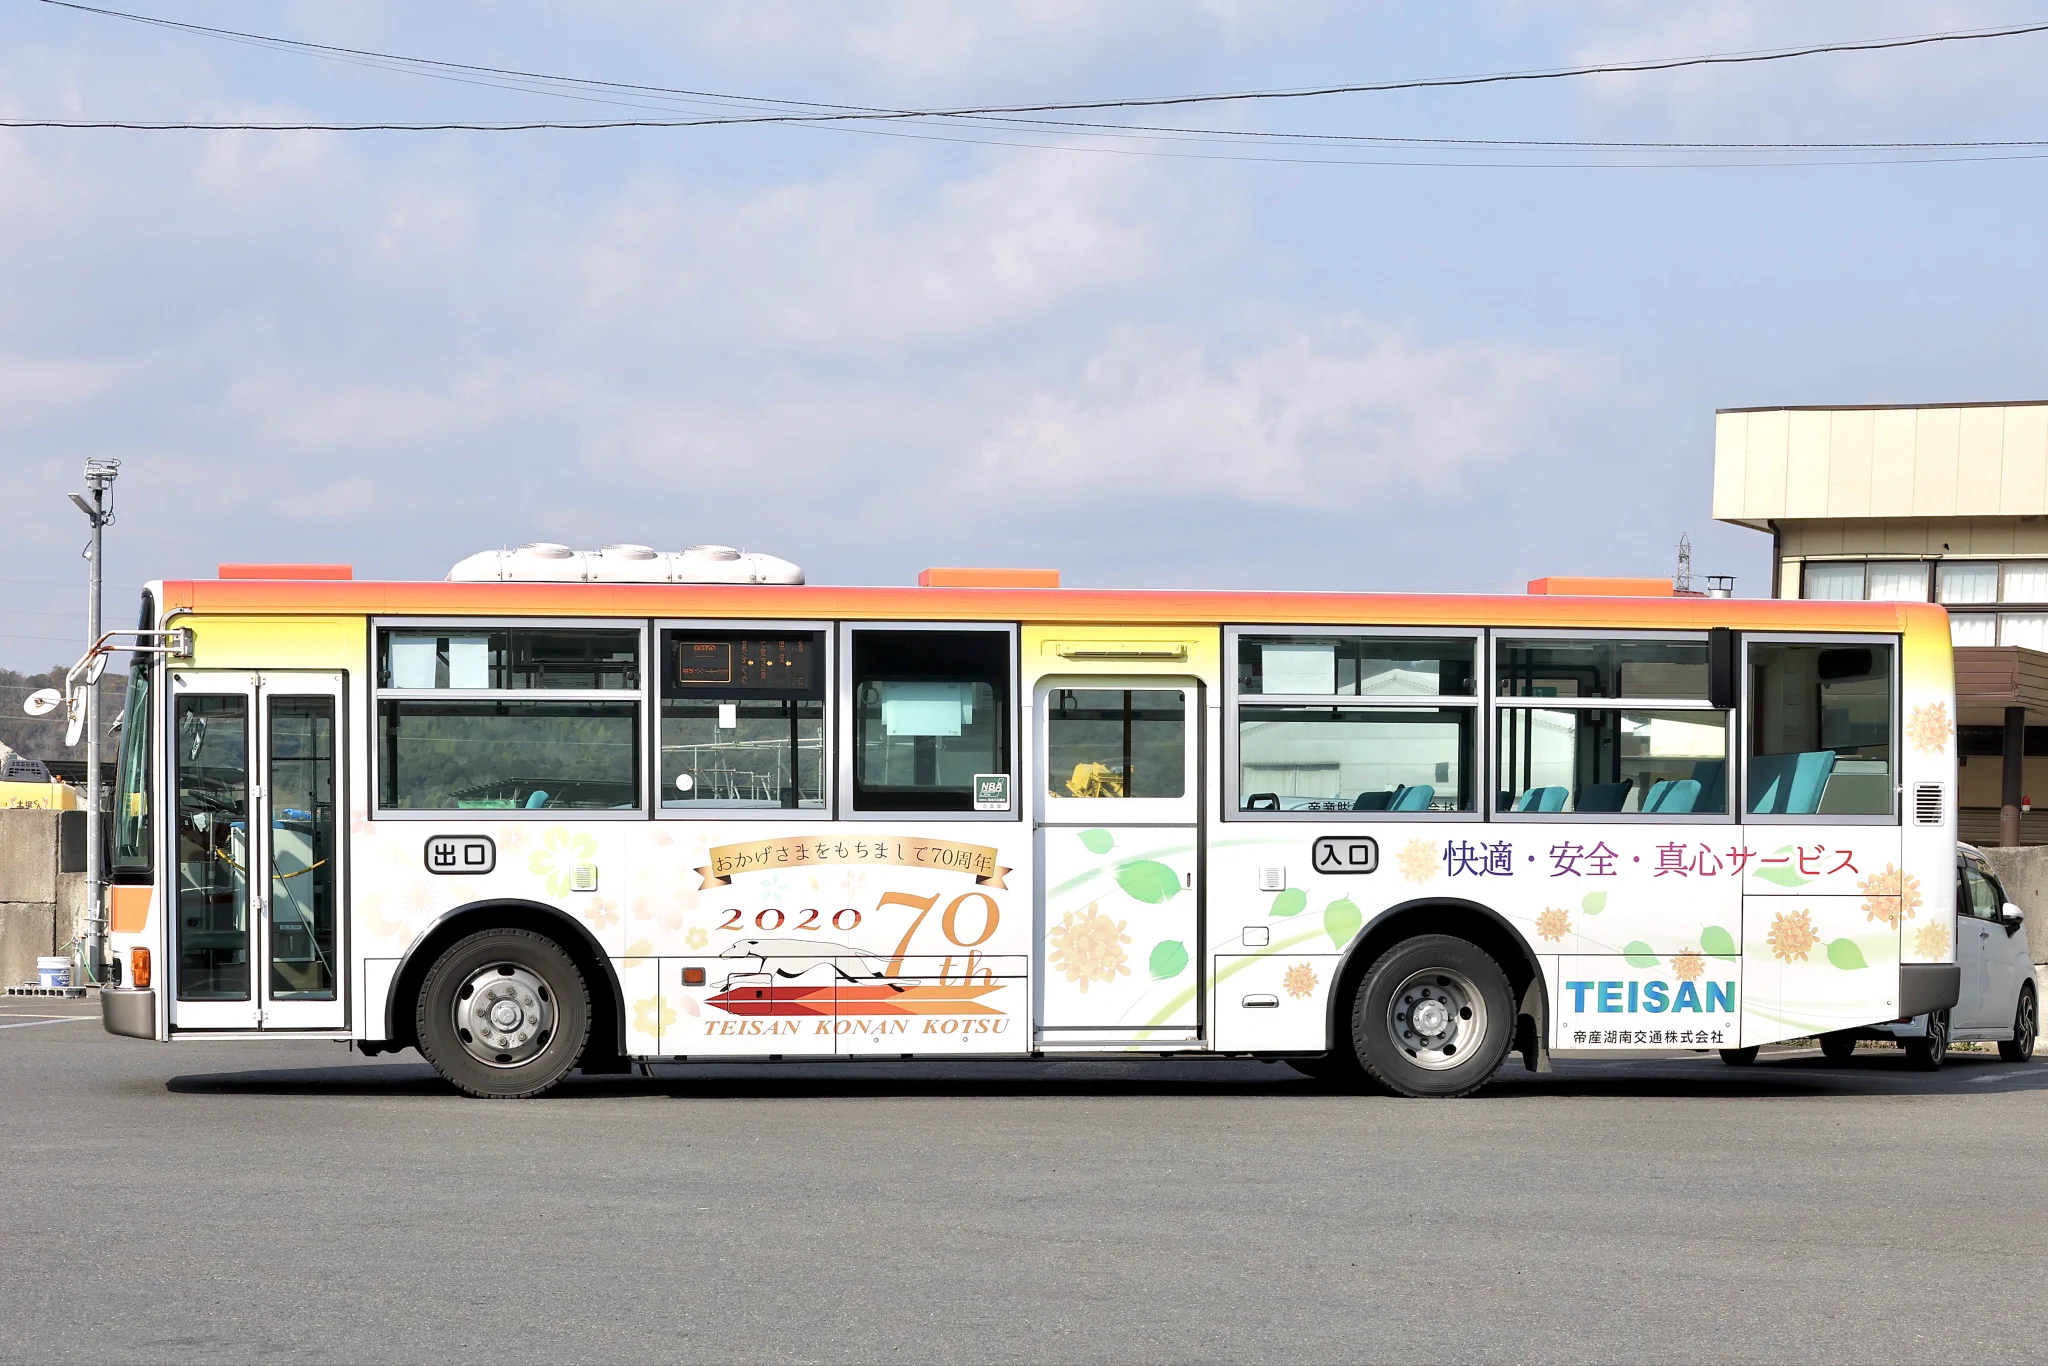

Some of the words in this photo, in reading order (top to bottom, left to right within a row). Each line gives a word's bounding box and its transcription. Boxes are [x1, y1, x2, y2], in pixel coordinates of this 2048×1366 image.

[981, 782, 1003, 792] NBA
[435, 843, 485, 866] 出口
[716, 842, 992, 873] おかげさまをもちまして70周年
[1321, 844, 1368, 865] 入口
[1443, 840, 1858, 877] 快適・安全・真心サービス
[716, 908, 861, 931] 2020
[1566, 981, 1735, 1013] TEISAN
[704, 1020, 802, 1036] TEISAN
[814, 1019, 909, 1035] KONAN
[922, 1018, 1010, 1034] KOTSU
[1573, 1030, 1724, 1044] 帝産湖南交通株式会社
